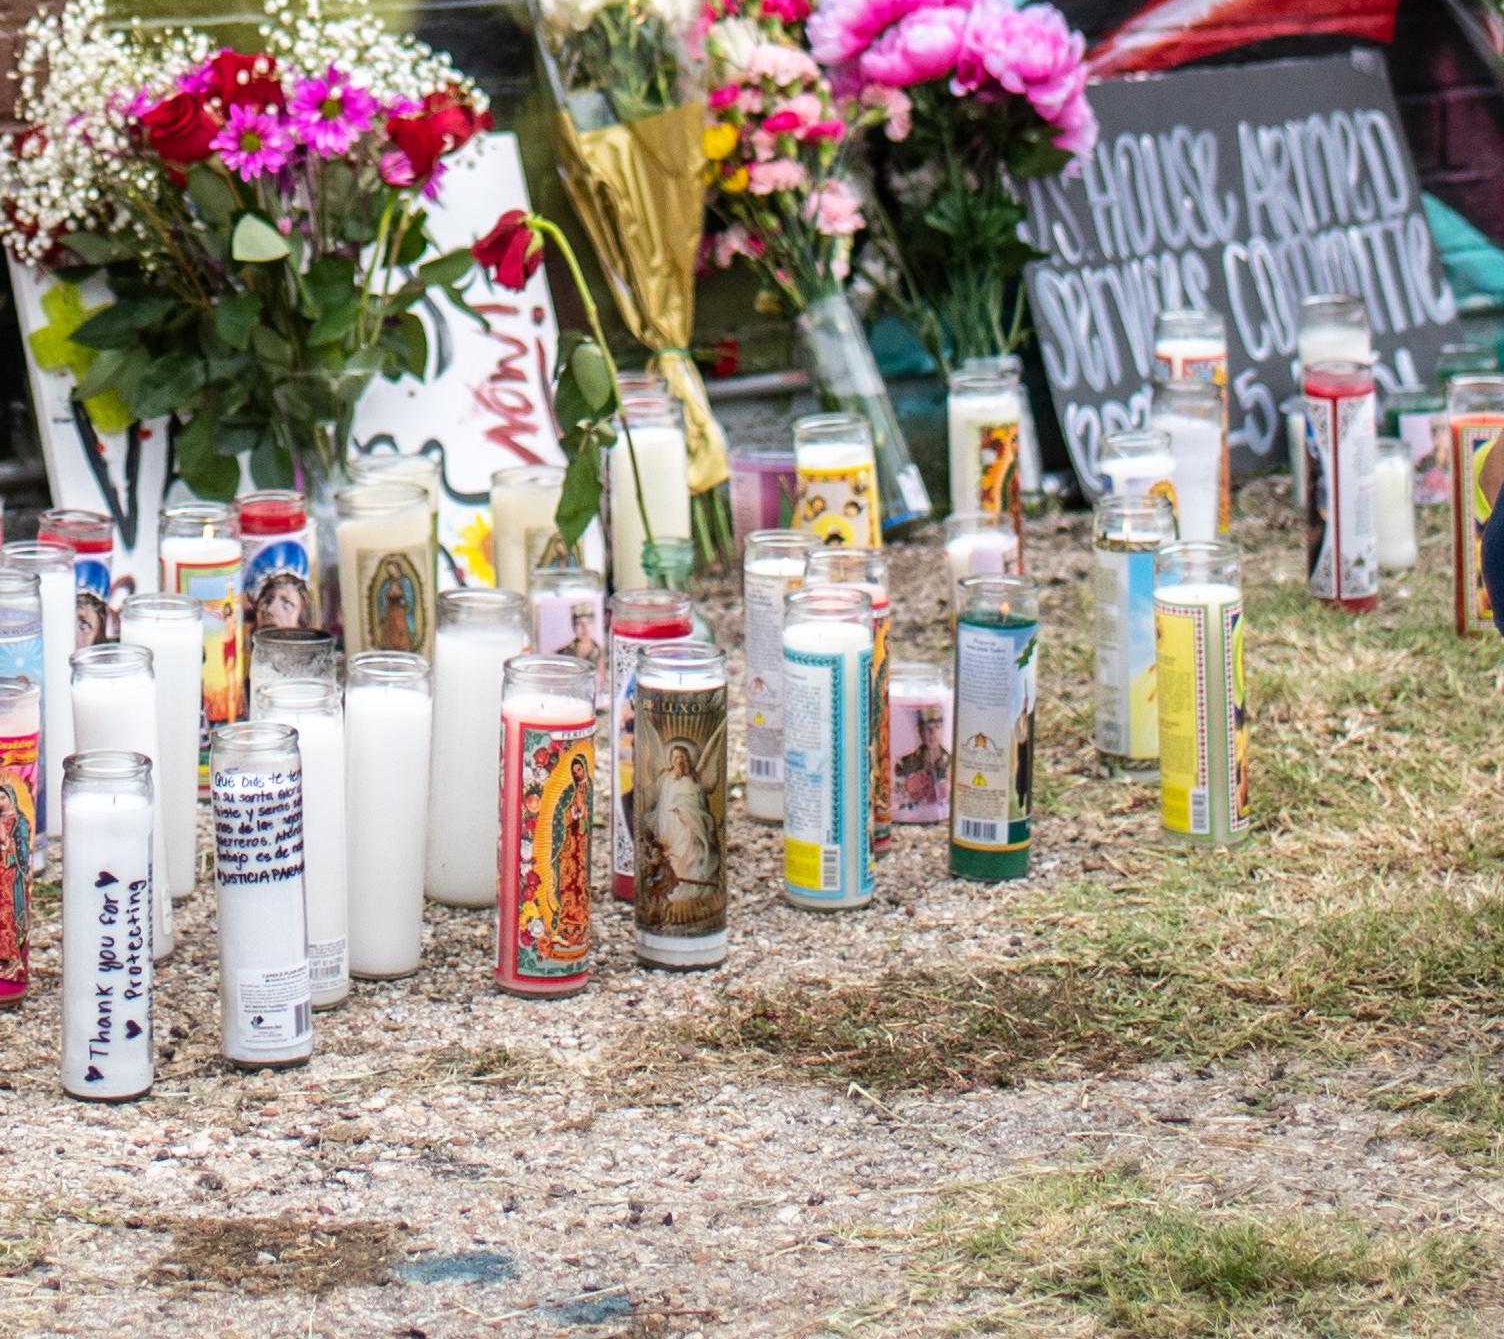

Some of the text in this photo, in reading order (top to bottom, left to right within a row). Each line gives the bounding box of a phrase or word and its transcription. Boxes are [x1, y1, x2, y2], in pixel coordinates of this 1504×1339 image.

[88, 892, 125, 1061] Thank you for
